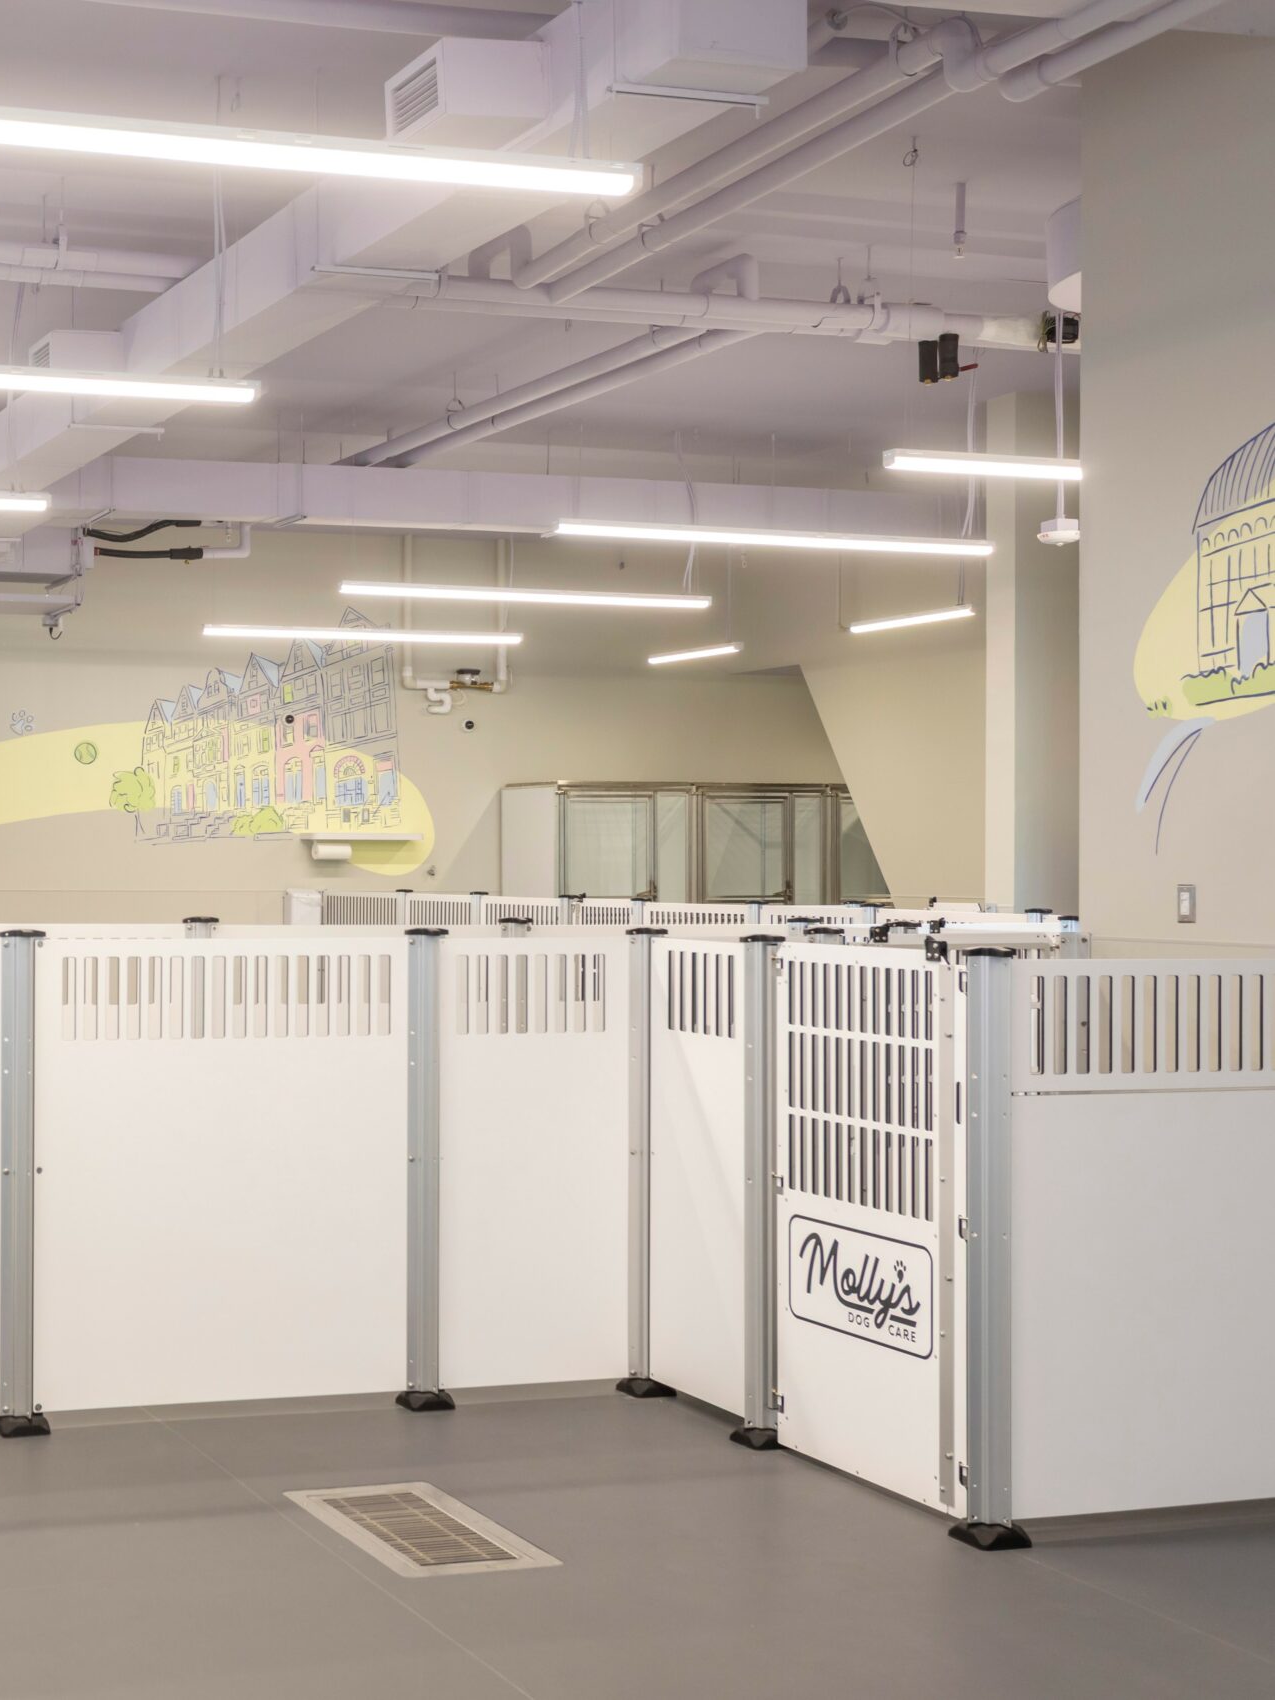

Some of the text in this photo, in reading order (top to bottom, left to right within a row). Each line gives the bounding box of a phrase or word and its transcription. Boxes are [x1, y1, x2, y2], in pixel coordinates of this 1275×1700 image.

[799, 1232, 921, 1329] Molly's
[847, 1312, 917, 1343] DOG CARE
